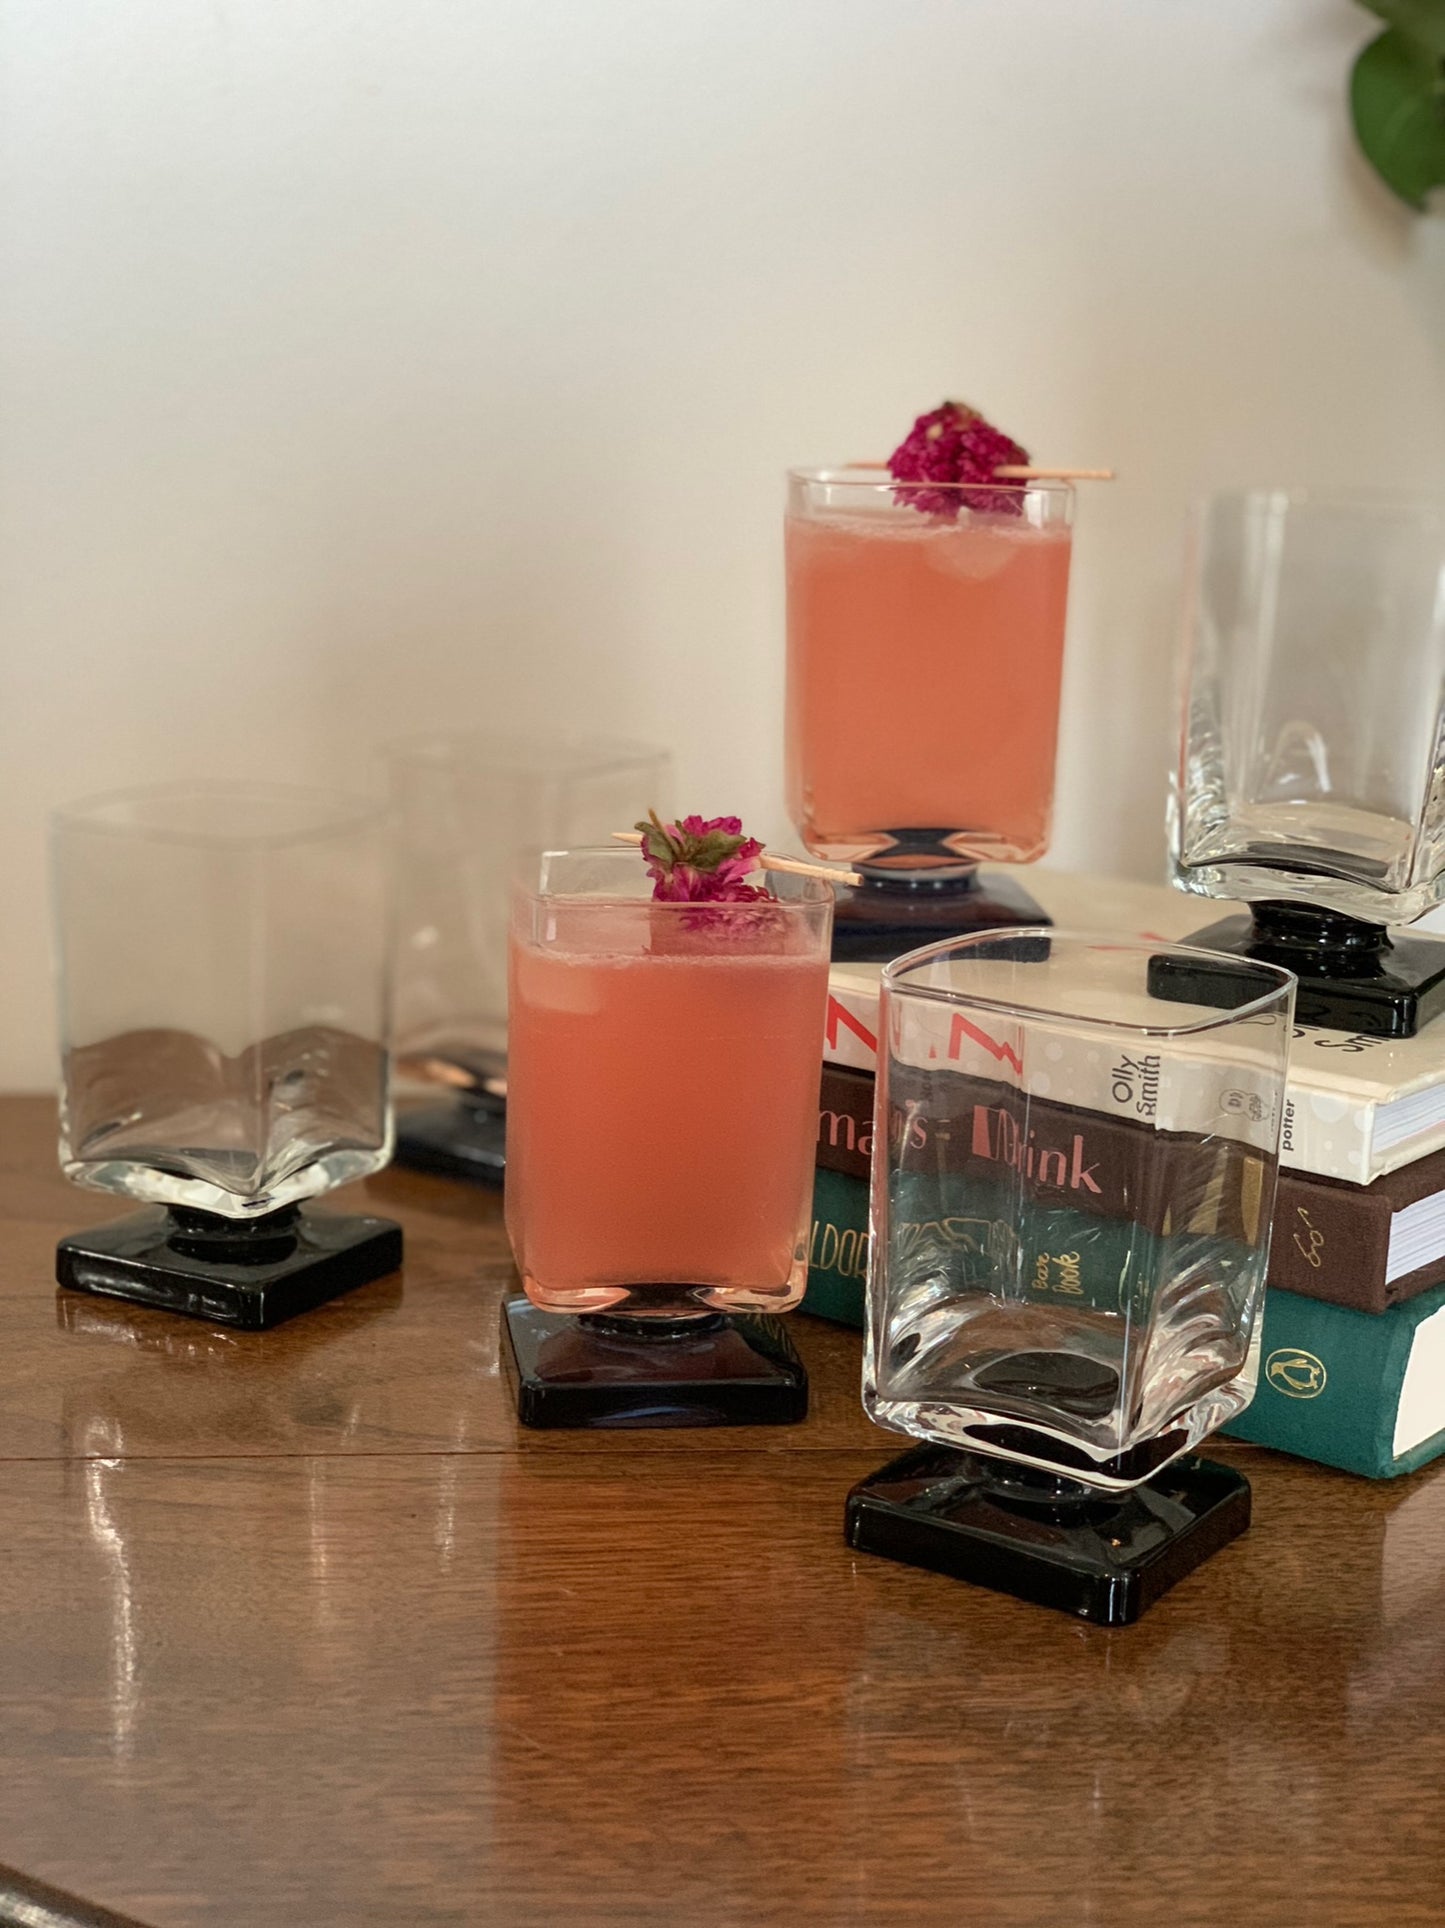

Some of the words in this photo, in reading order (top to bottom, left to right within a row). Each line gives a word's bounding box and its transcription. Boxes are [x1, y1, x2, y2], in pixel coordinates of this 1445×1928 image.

[1111, 1054, 1139, 1104] Olly
[1135, 1054, 1161, 1117] Smith
[1281, 1098, 1296, 1152] potter
